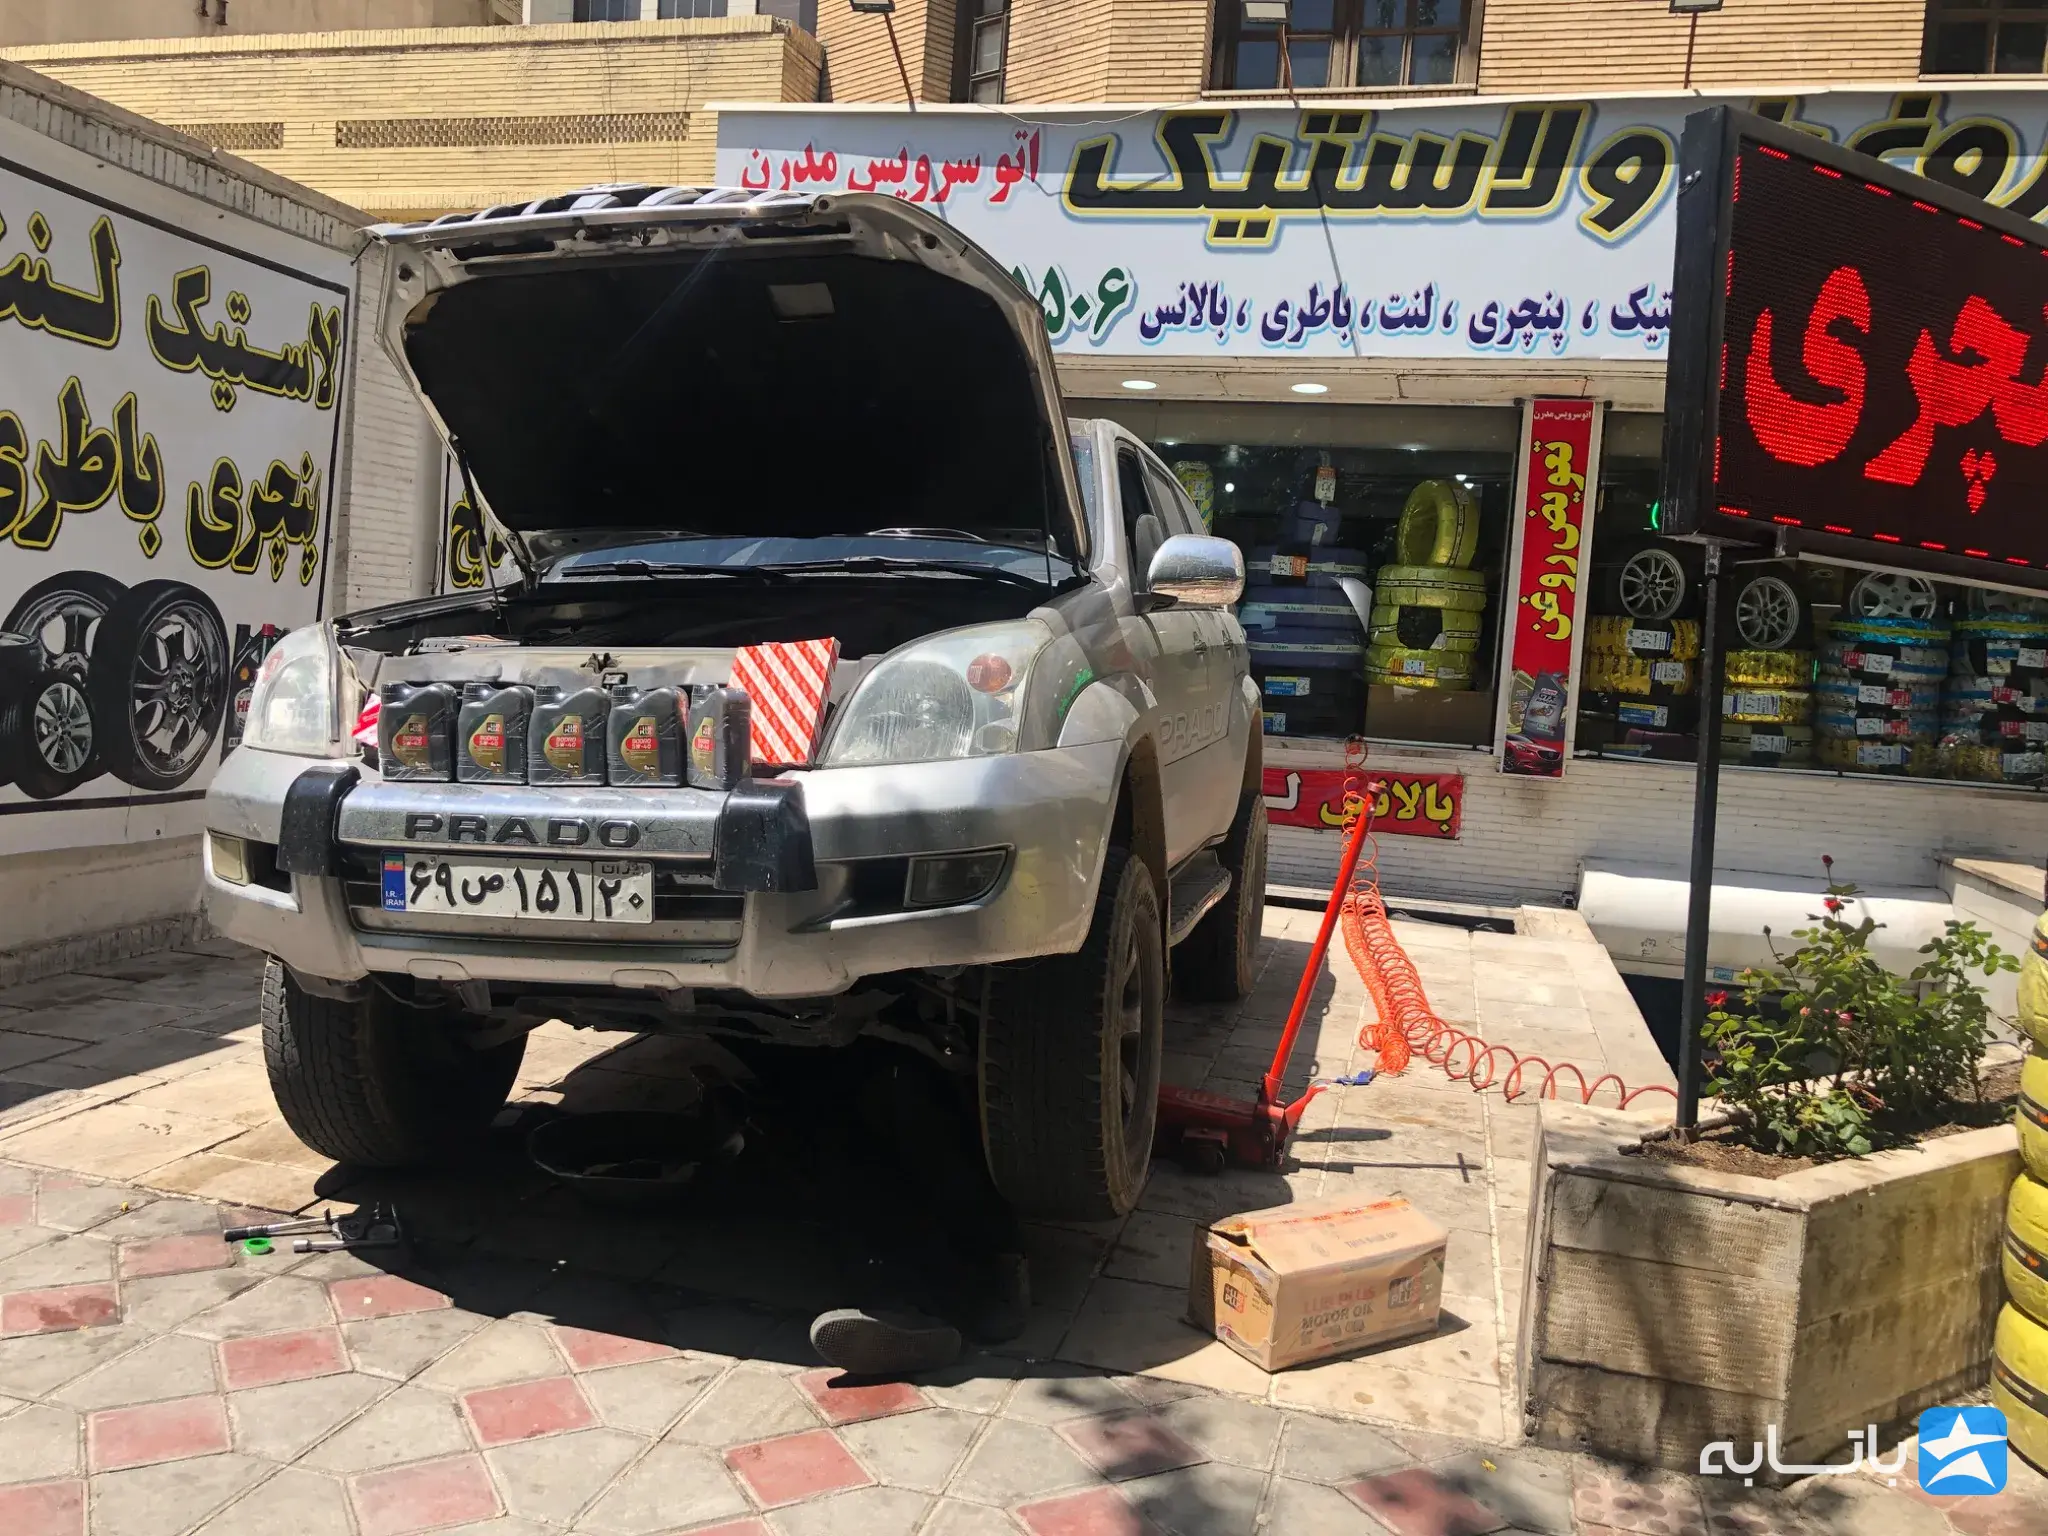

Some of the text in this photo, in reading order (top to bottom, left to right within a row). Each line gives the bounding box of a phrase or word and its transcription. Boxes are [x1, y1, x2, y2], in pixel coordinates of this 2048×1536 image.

[741, 127, 1041, 202] اتو سرویس مدرن
[1140, 281, 1228, 339] بالانس
[1262, 283, 1351, 342] باطری
[1380, 281, 1434, 330] لنت
[1469, 291, 1565, 348] پنچری
[1611, 283, 1673, 343] تیک
[145, 264, 341, 411] لاستیک
[186, 452, 323, 585] پنچری
[1519, 440, 1585, 641] تعویض روغن
[1158, 702, 1224, 755] PRADO
[404, 812, 642, 847] PRADO
[385, 898, 405, 907] IRAN
[1301, 1302, 1375, 1329] MOTOR OIL
